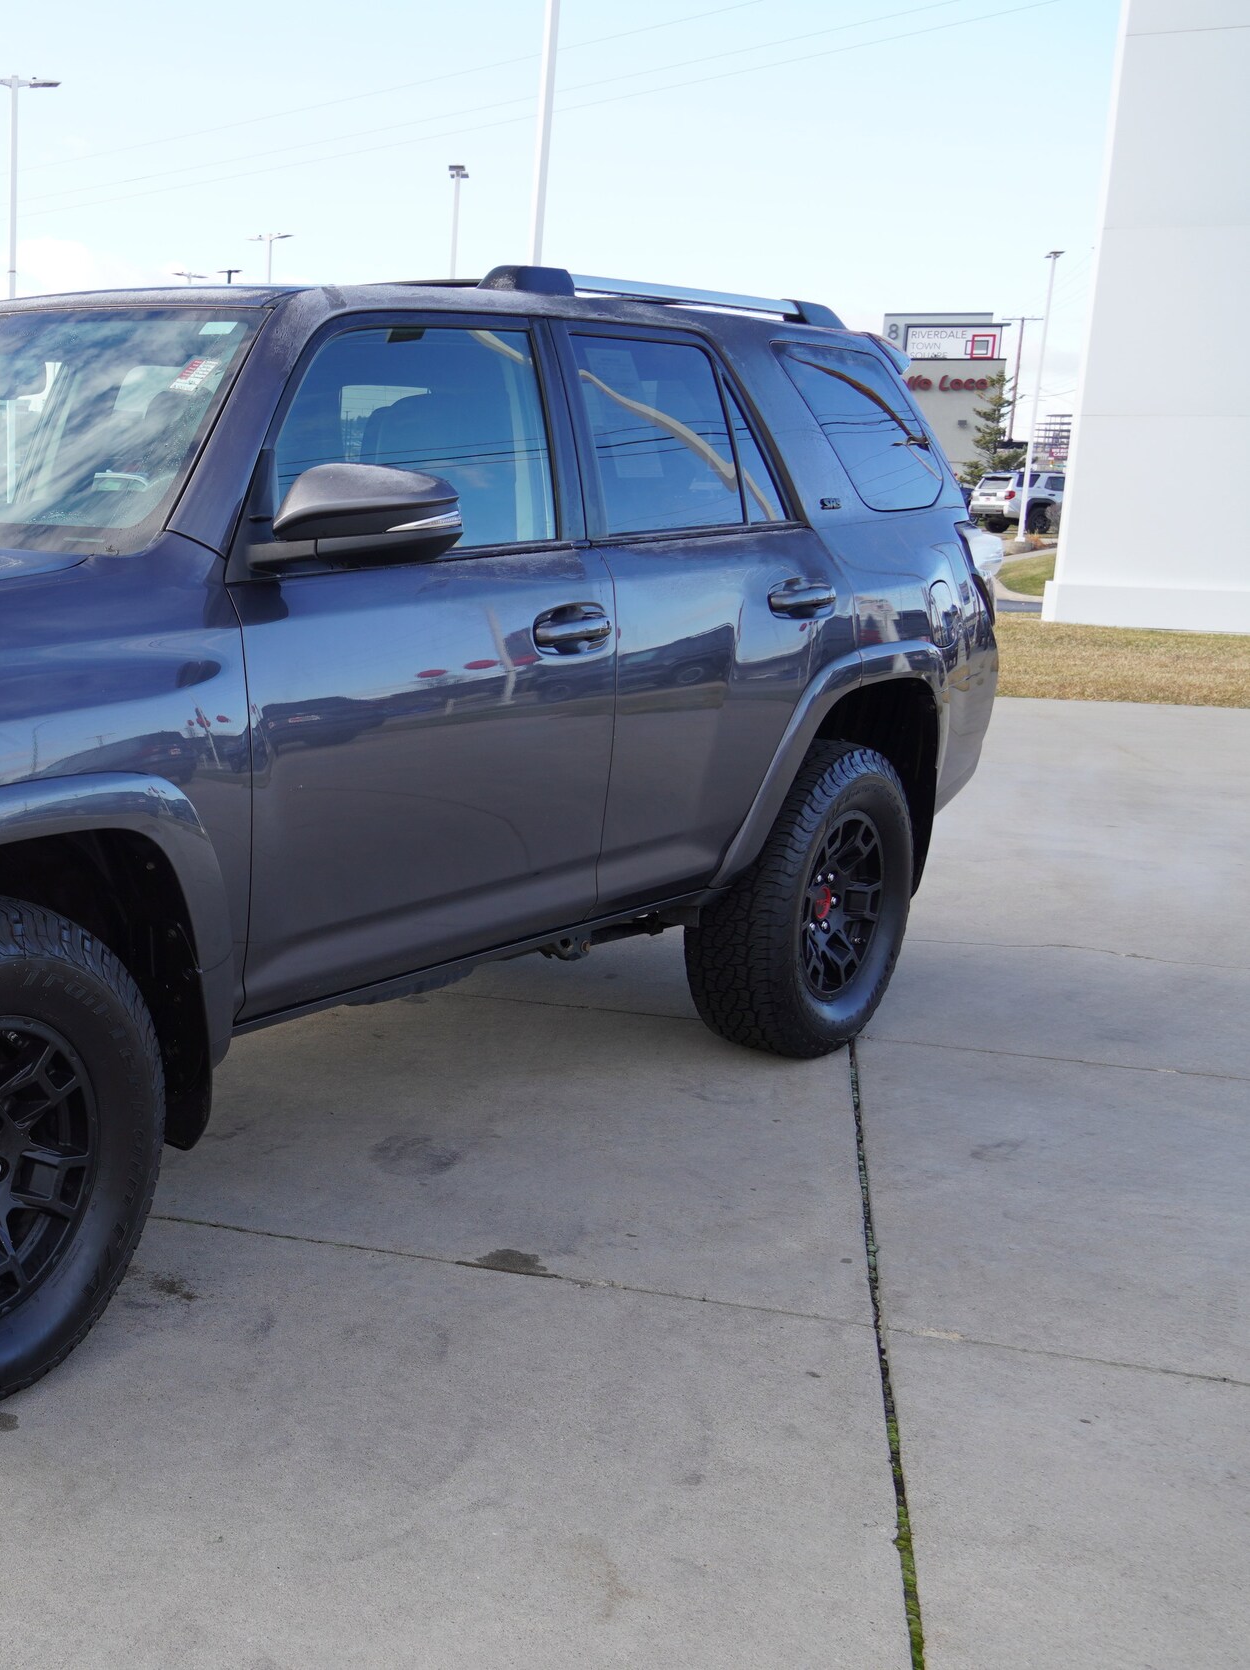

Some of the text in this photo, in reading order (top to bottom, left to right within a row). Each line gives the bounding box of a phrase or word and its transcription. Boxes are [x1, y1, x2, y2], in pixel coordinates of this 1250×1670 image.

[888, 323, 899, 340] 8
[911, 330, 968, 340] RIVERDALE
[911, 342, 941, 350] TOWN
[938, 374, 990, 391] Loco
